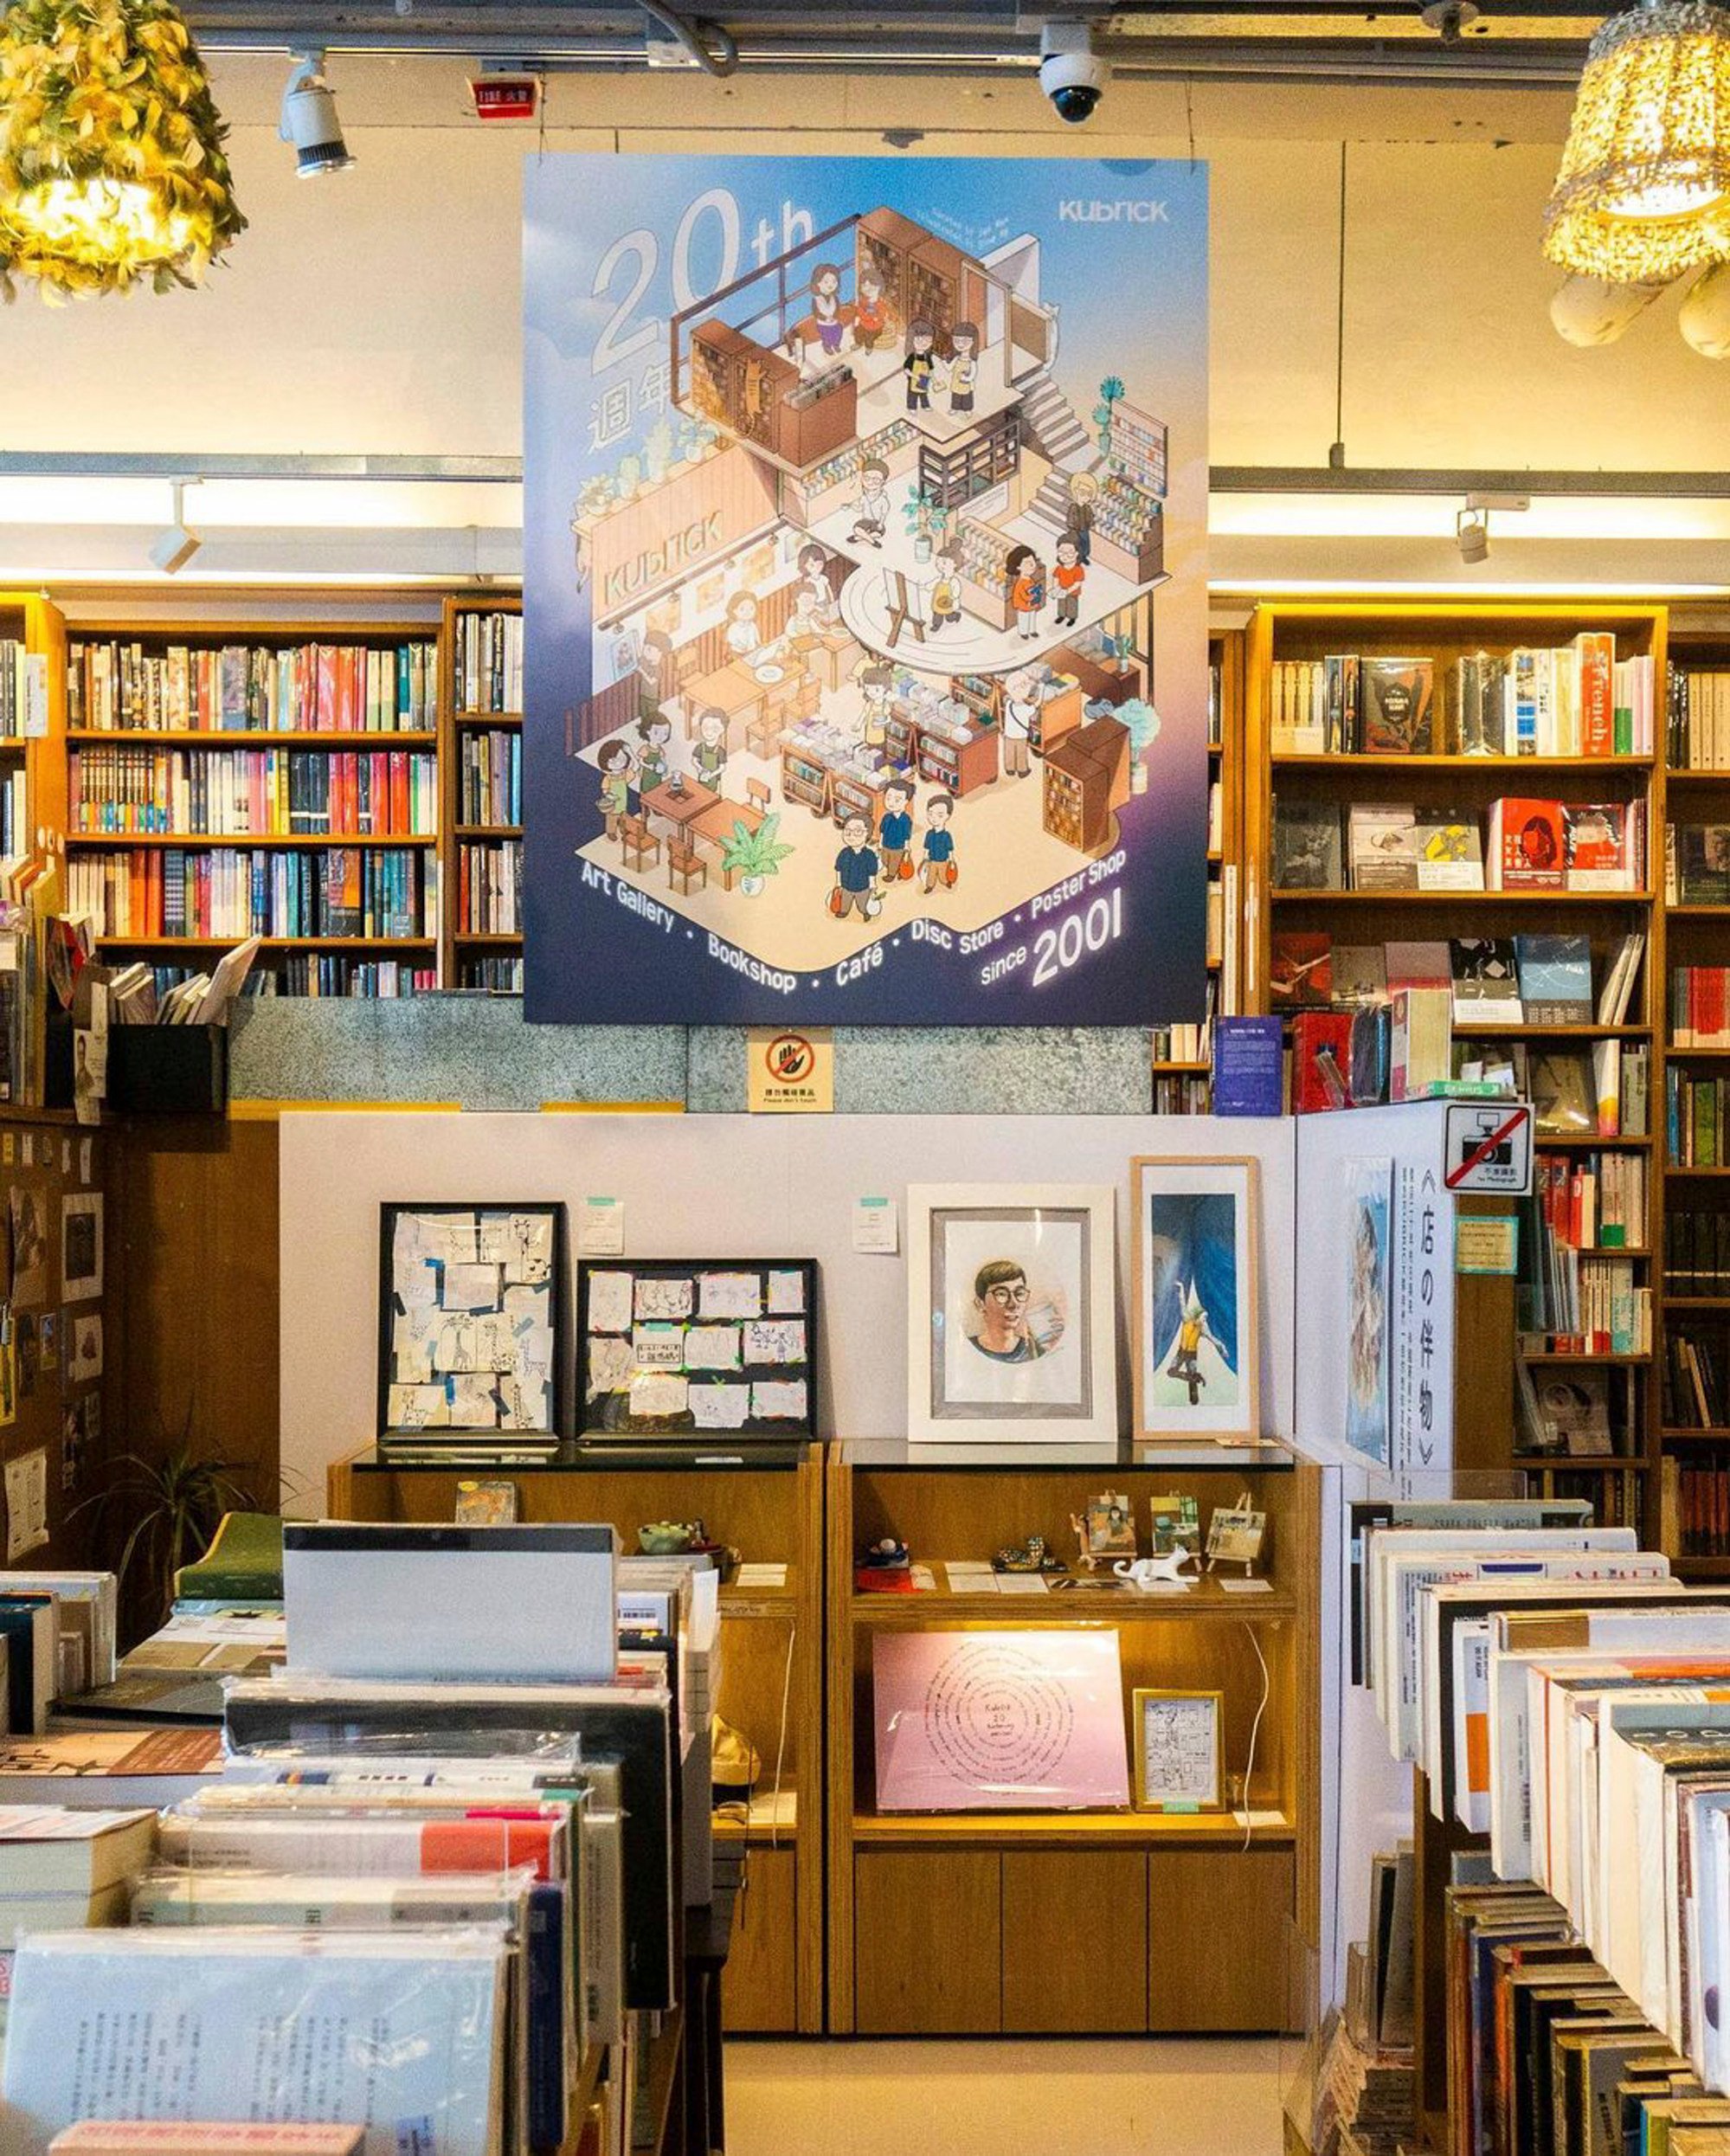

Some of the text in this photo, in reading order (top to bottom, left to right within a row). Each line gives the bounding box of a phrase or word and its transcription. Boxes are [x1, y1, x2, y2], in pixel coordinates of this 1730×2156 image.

[590, 188, 814, 377] 20th
[581, 850, 1126, 994] Art Gallery Bookshop Café Disc Store Poster Shop
[981, 887, 1122, 987] since 2001
